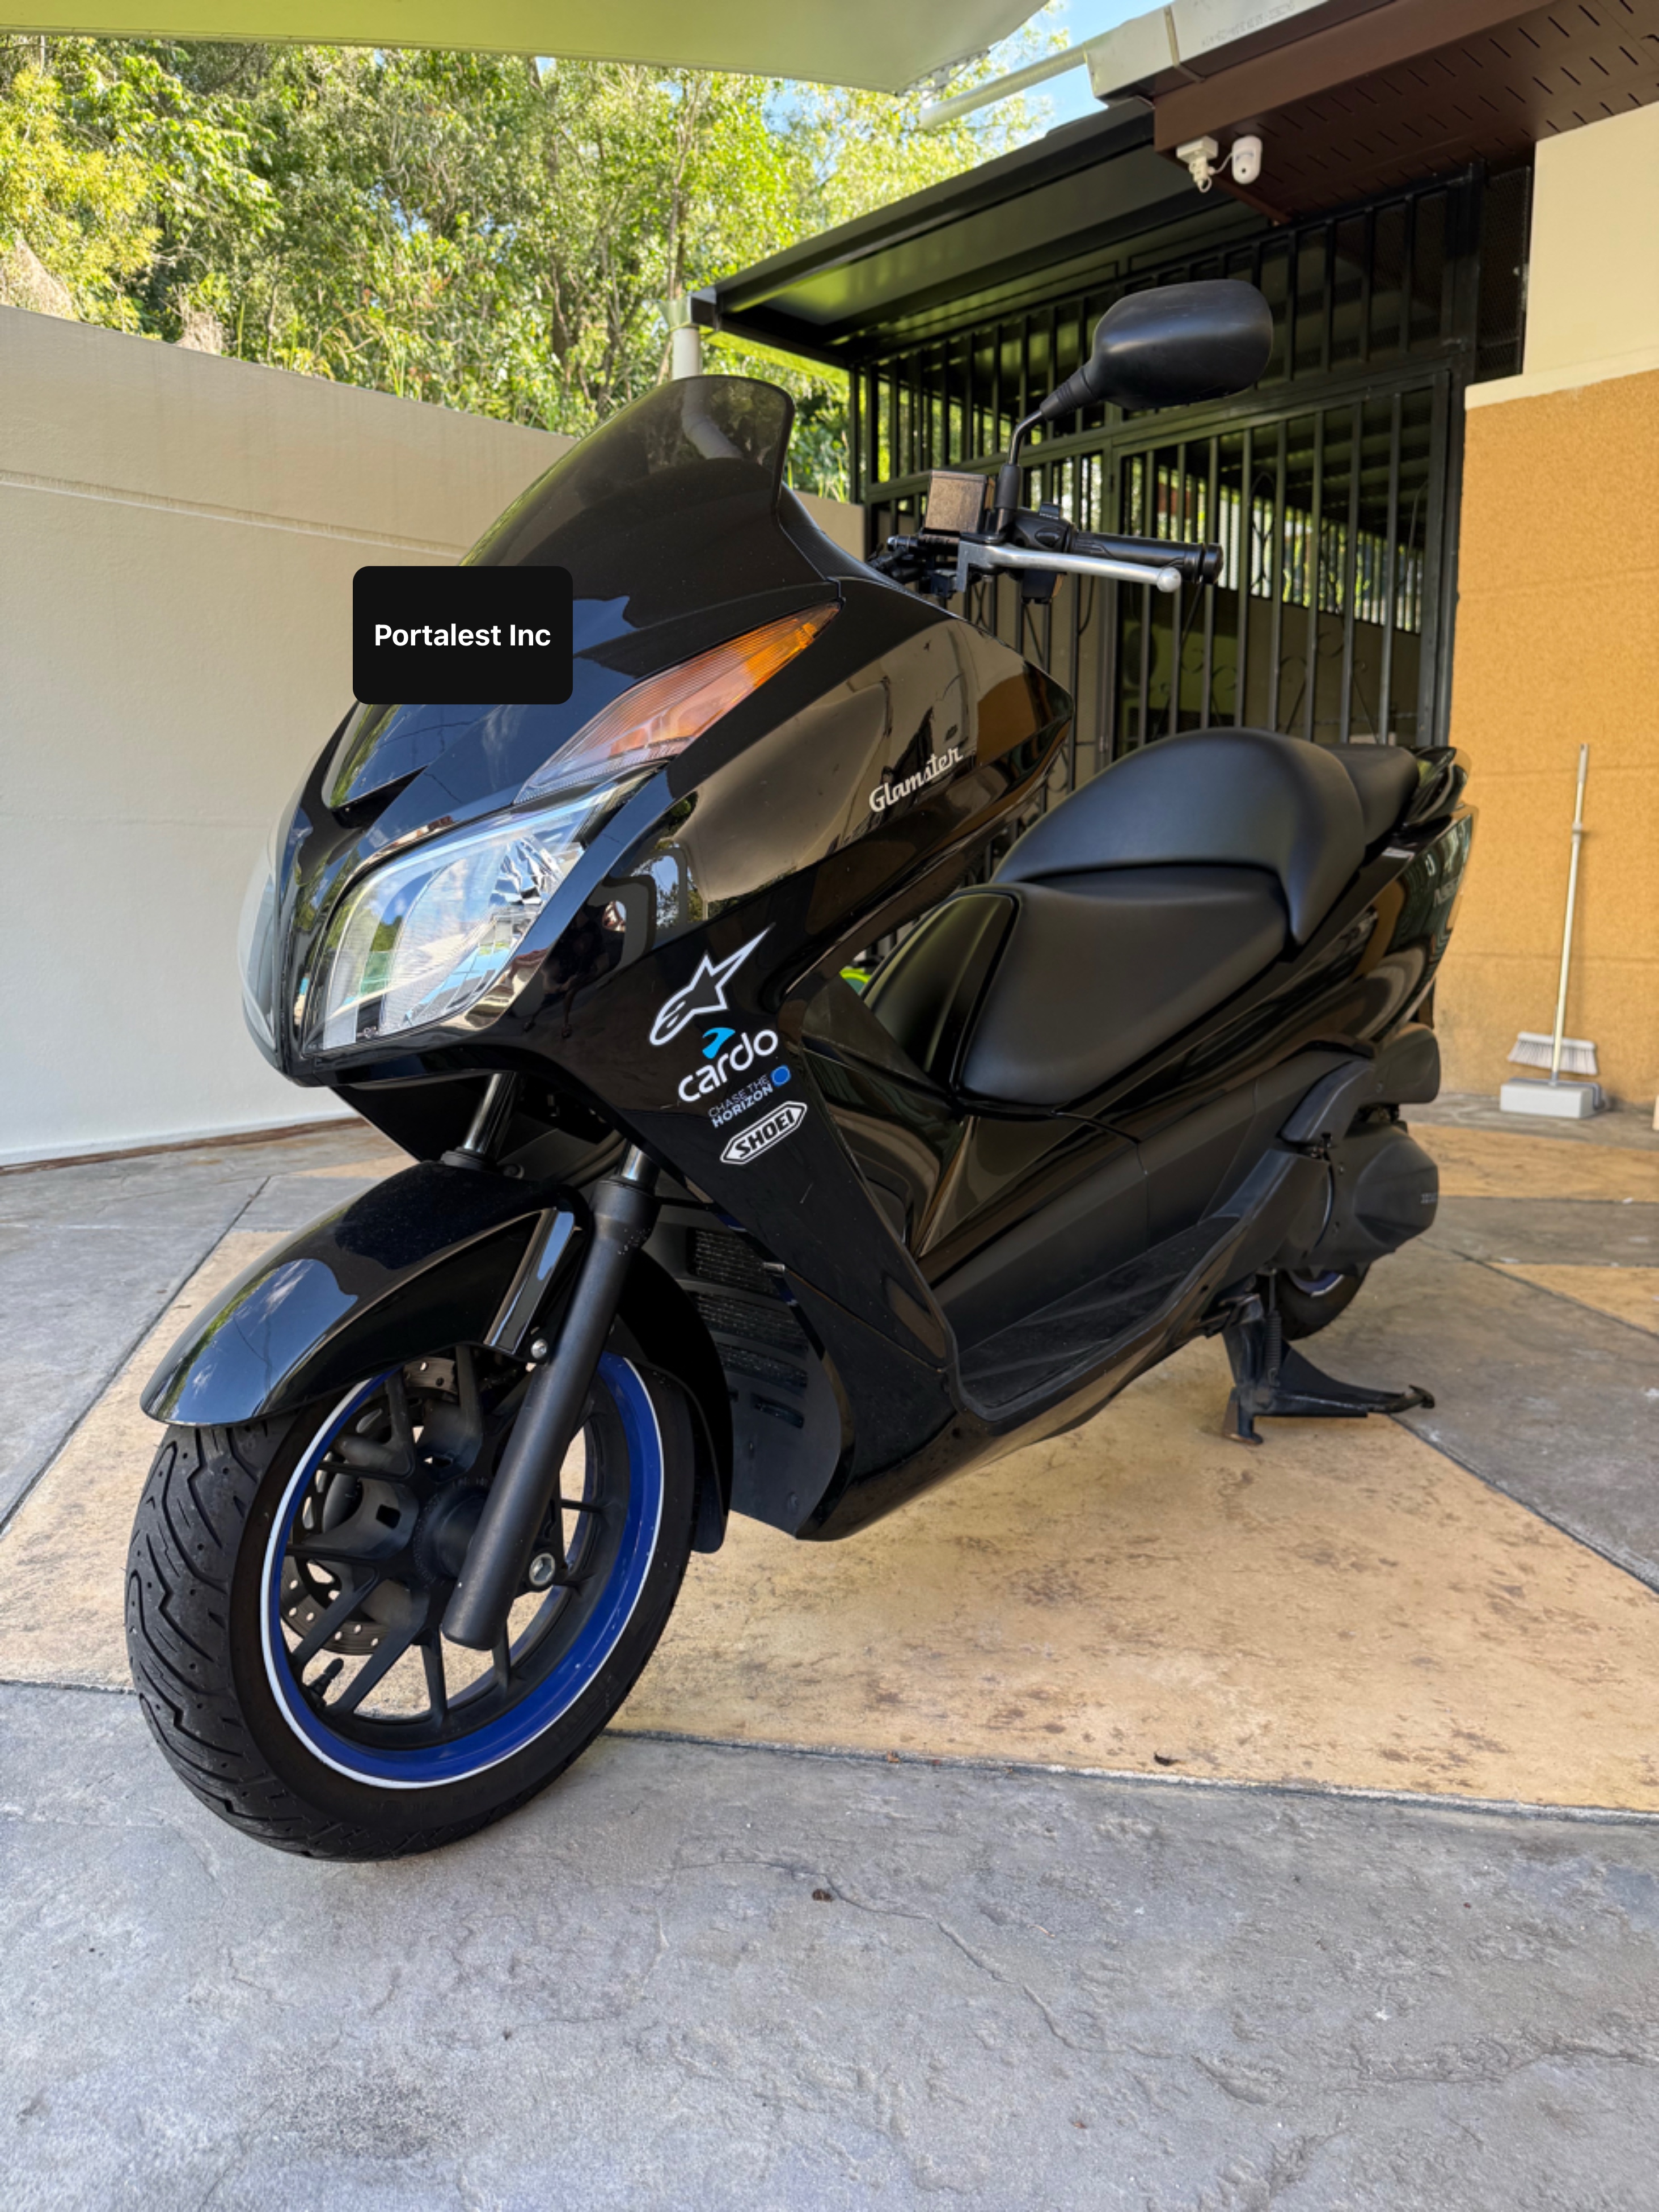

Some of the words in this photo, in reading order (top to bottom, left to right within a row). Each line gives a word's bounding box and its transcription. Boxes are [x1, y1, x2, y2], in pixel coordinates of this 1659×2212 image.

[678, 1029, 778, 1102] cardo
[708, 1089, 746, 1117] CHASE
[712, 1083, 773, 1128] HORIZON
[735, 1109, 794, 1158] SHOEI
